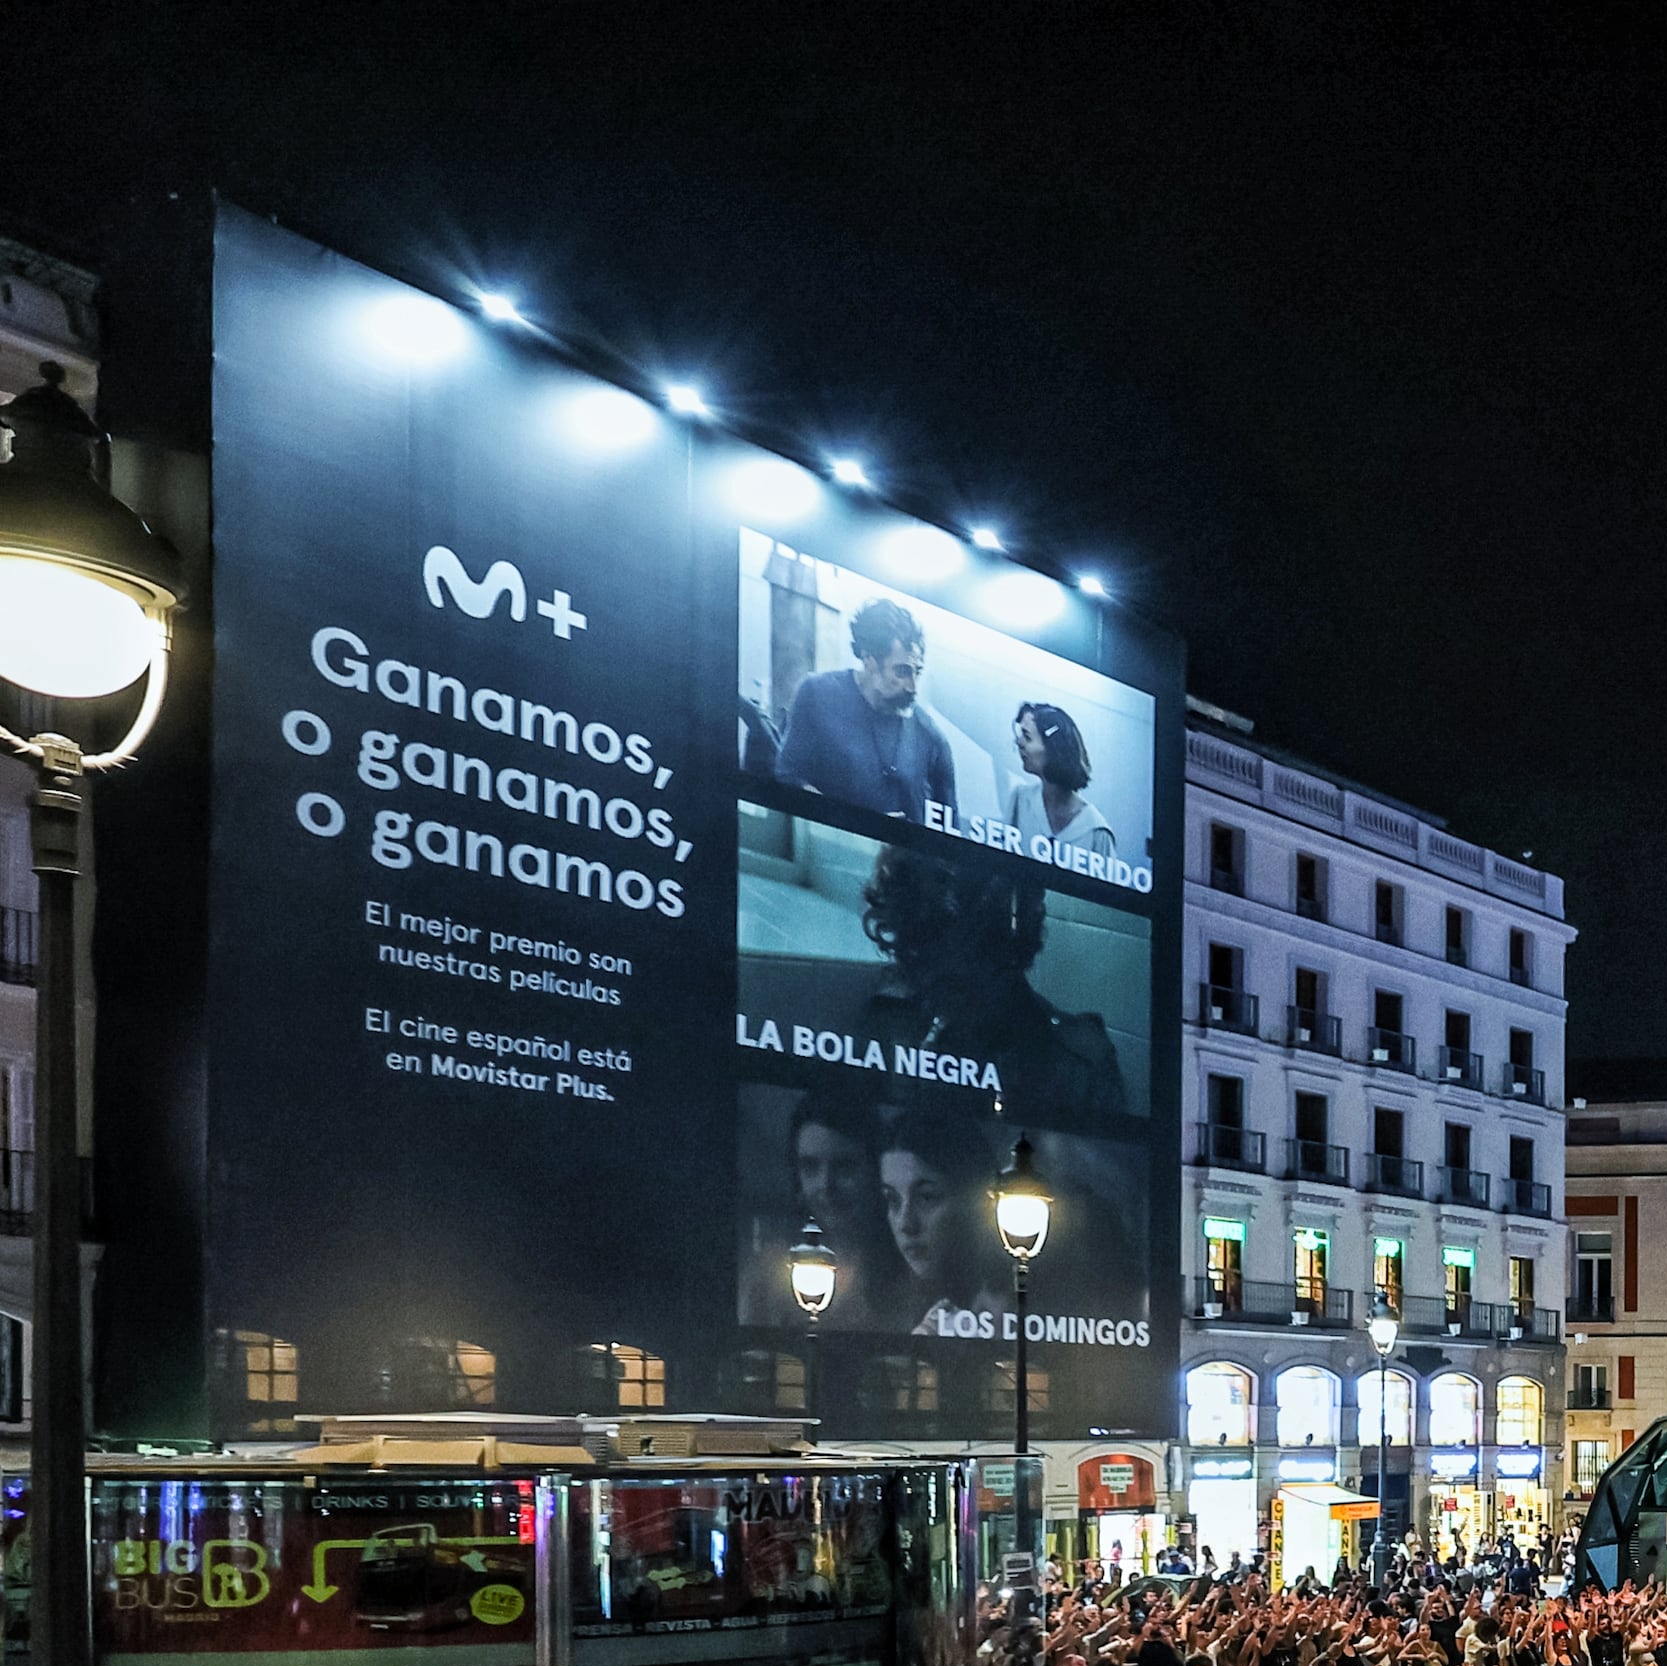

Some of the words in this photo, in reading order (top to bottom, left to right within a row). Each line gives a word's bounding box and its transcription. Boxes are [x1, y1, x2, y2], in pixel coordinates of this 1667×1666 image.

[311, 626, 673, 790] Ganamos,
[281, 710, 332, 756] o
[357, 730, 693, 863] ganamos,
[296, 792, 346, 837] o
[371, 810, 686, 918] ganamos
[924, 799, 961, 837] EL
[968, 815, 1024, 856] SER
[1030, 834, 1153, 894] QUERIDO
[365, 900, 391, 926] El
[400, 911, 482, 945] mejor
[489, 930, 582, 966] premio
[588, 951, 632, 975] son
[378, 944, 501, 983] nuestras
[510, 970, 622, 1006] películas
[365, 1007, 391, 1033] El
[400, 1016, 459, 1044] cine
[466, 1030, 571, 1062] español
[578, 1050, 632, 1072] está
[736, 1013, 784, 1052] LA
[793, 1025, 887, 1071] BOLA
[895, 1044, 1002, 1092] NEGRA
[386, 1052, 422, 1074] en
[431, 1054, 550, 1092] Movistar
[557, 1073, 615, 1101] Plus.
[937, 1308, 995, 1340] LOS
[1003, 1312, 1150, 1347] DOMINGOS
[312, 1495, 389, 1509] DRINKS
[115, 1540, 197, 1575] BIG
[115, 1577, 199, 1610] BUS
[481, 1590, 520, 1606] LIVE
[645, 1618, 712, 1634] REVISTA
